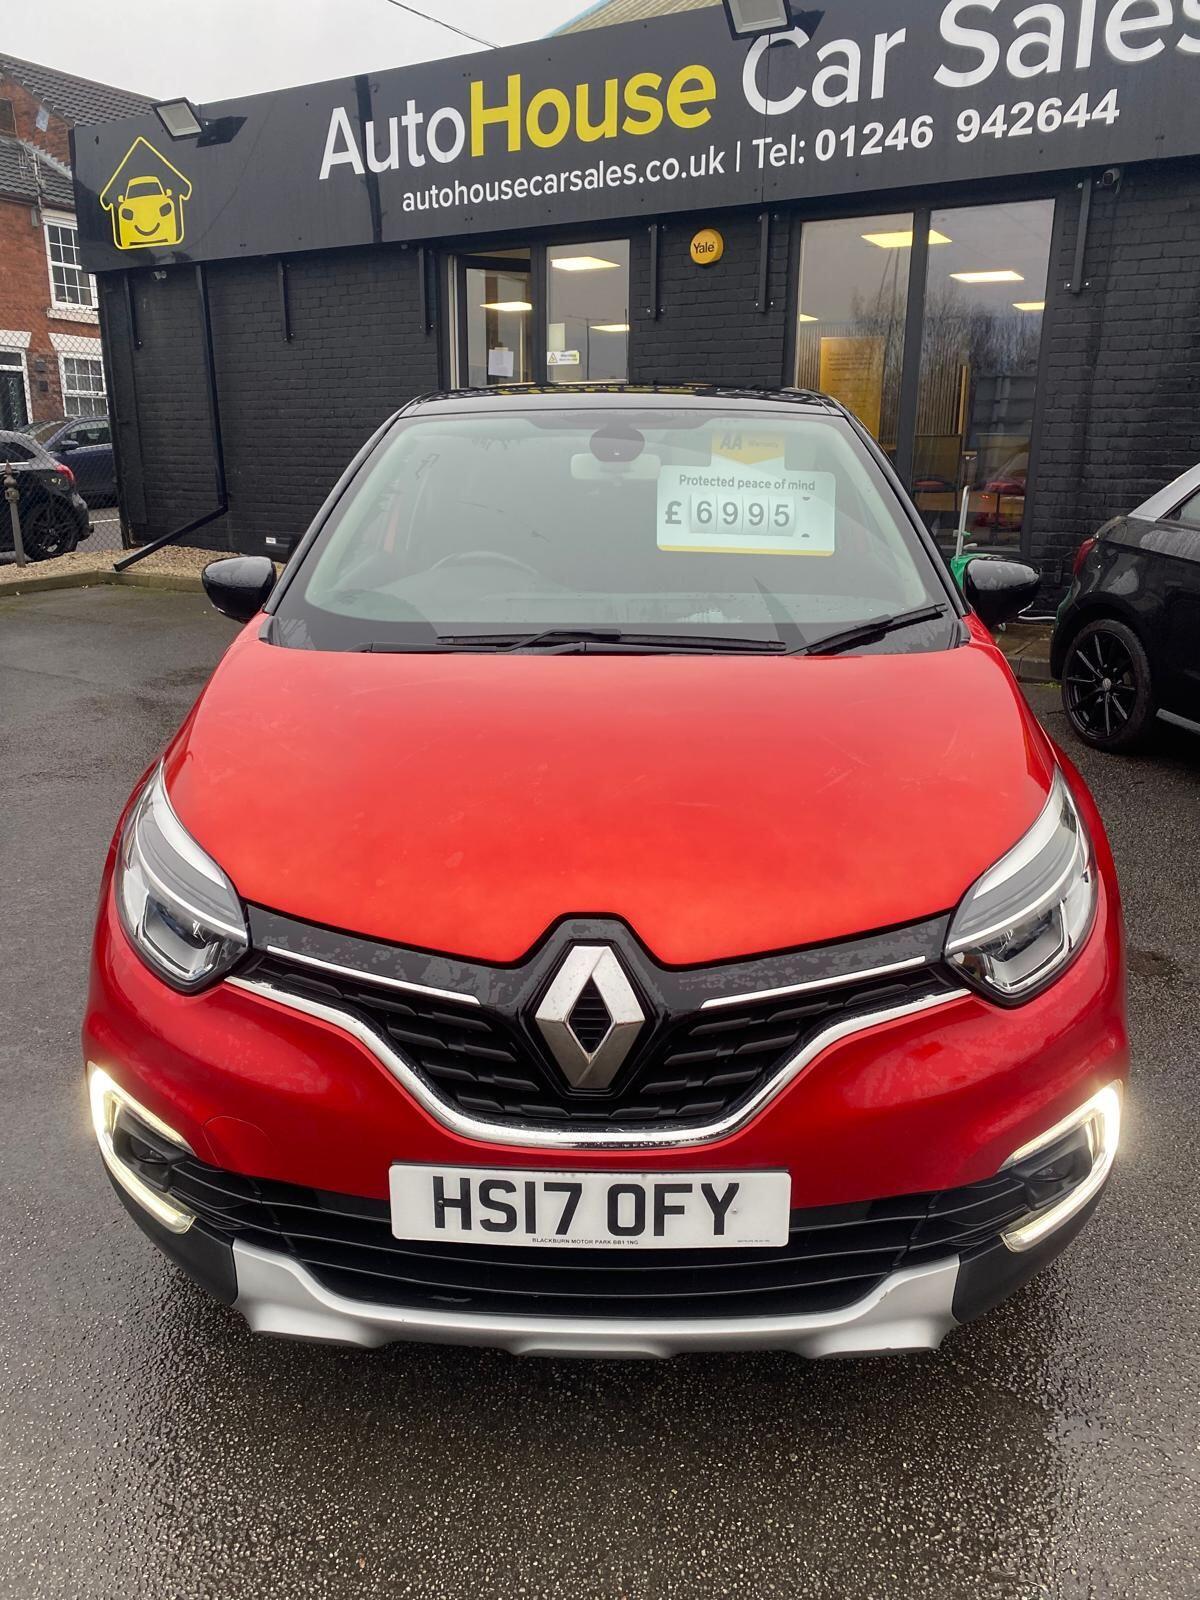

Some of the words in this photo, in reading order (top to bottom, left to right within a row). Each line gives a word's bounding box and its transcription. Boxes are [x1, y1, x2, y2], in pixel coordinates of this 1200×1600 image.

[319, 64, 717, 180] AutoHouse
[742, 25, 906, 116] Car
[402, 145, 725, 212] autohousecarsales.co.uk
[752, 134, 805, 169] Tel:
[814, 114, 934, 161] 01246
[956, 88, 1120, 144] 942644
[693, 241, 715, 254] Yale
[719, 431, 742, 450] AA
[679, 474, 735, 488] Protected
[737, 479, 772, 490] peace
[774, 478, 787, 489] of
[788, 480, 816, 491] mind
[432, 1175, 583, 1236] HS17
[607, 1182, 740, 1237] OFY
